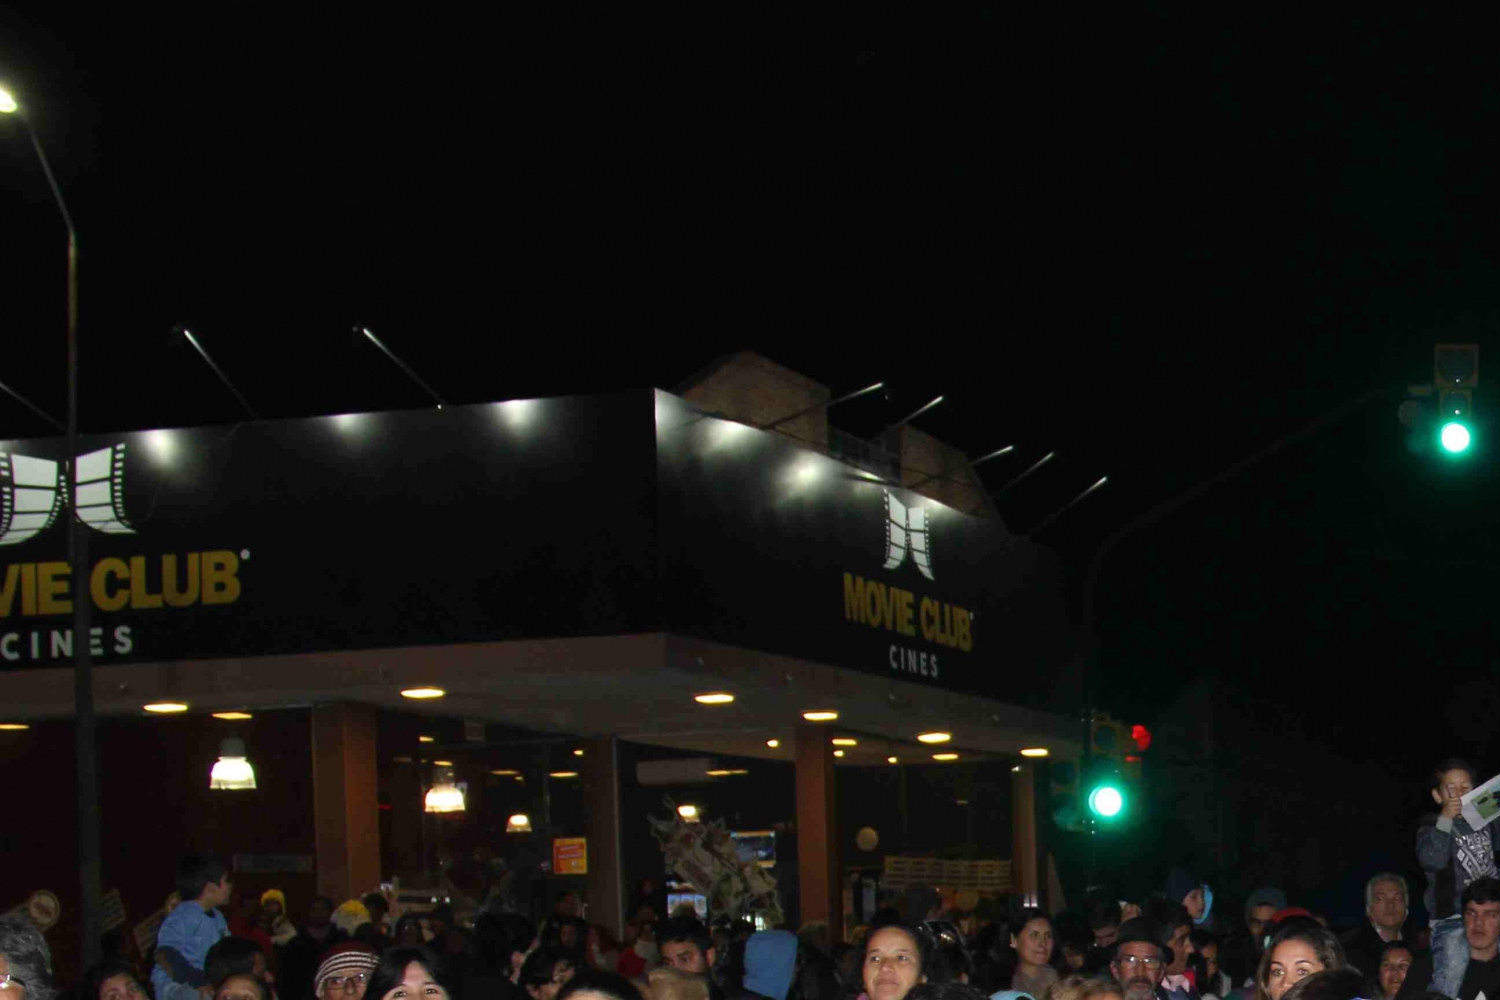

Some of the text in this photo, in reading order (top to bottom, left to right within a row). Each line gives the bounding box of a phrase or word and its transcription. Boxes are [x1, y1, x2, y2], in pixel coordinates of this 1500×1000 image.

[90, 550, 241, 612] CLUB
[843, 572, 973, 653] MOVIE CLUB
[0, 625, 133, 660] CINES
[889, 644, 938, 679] CINES
